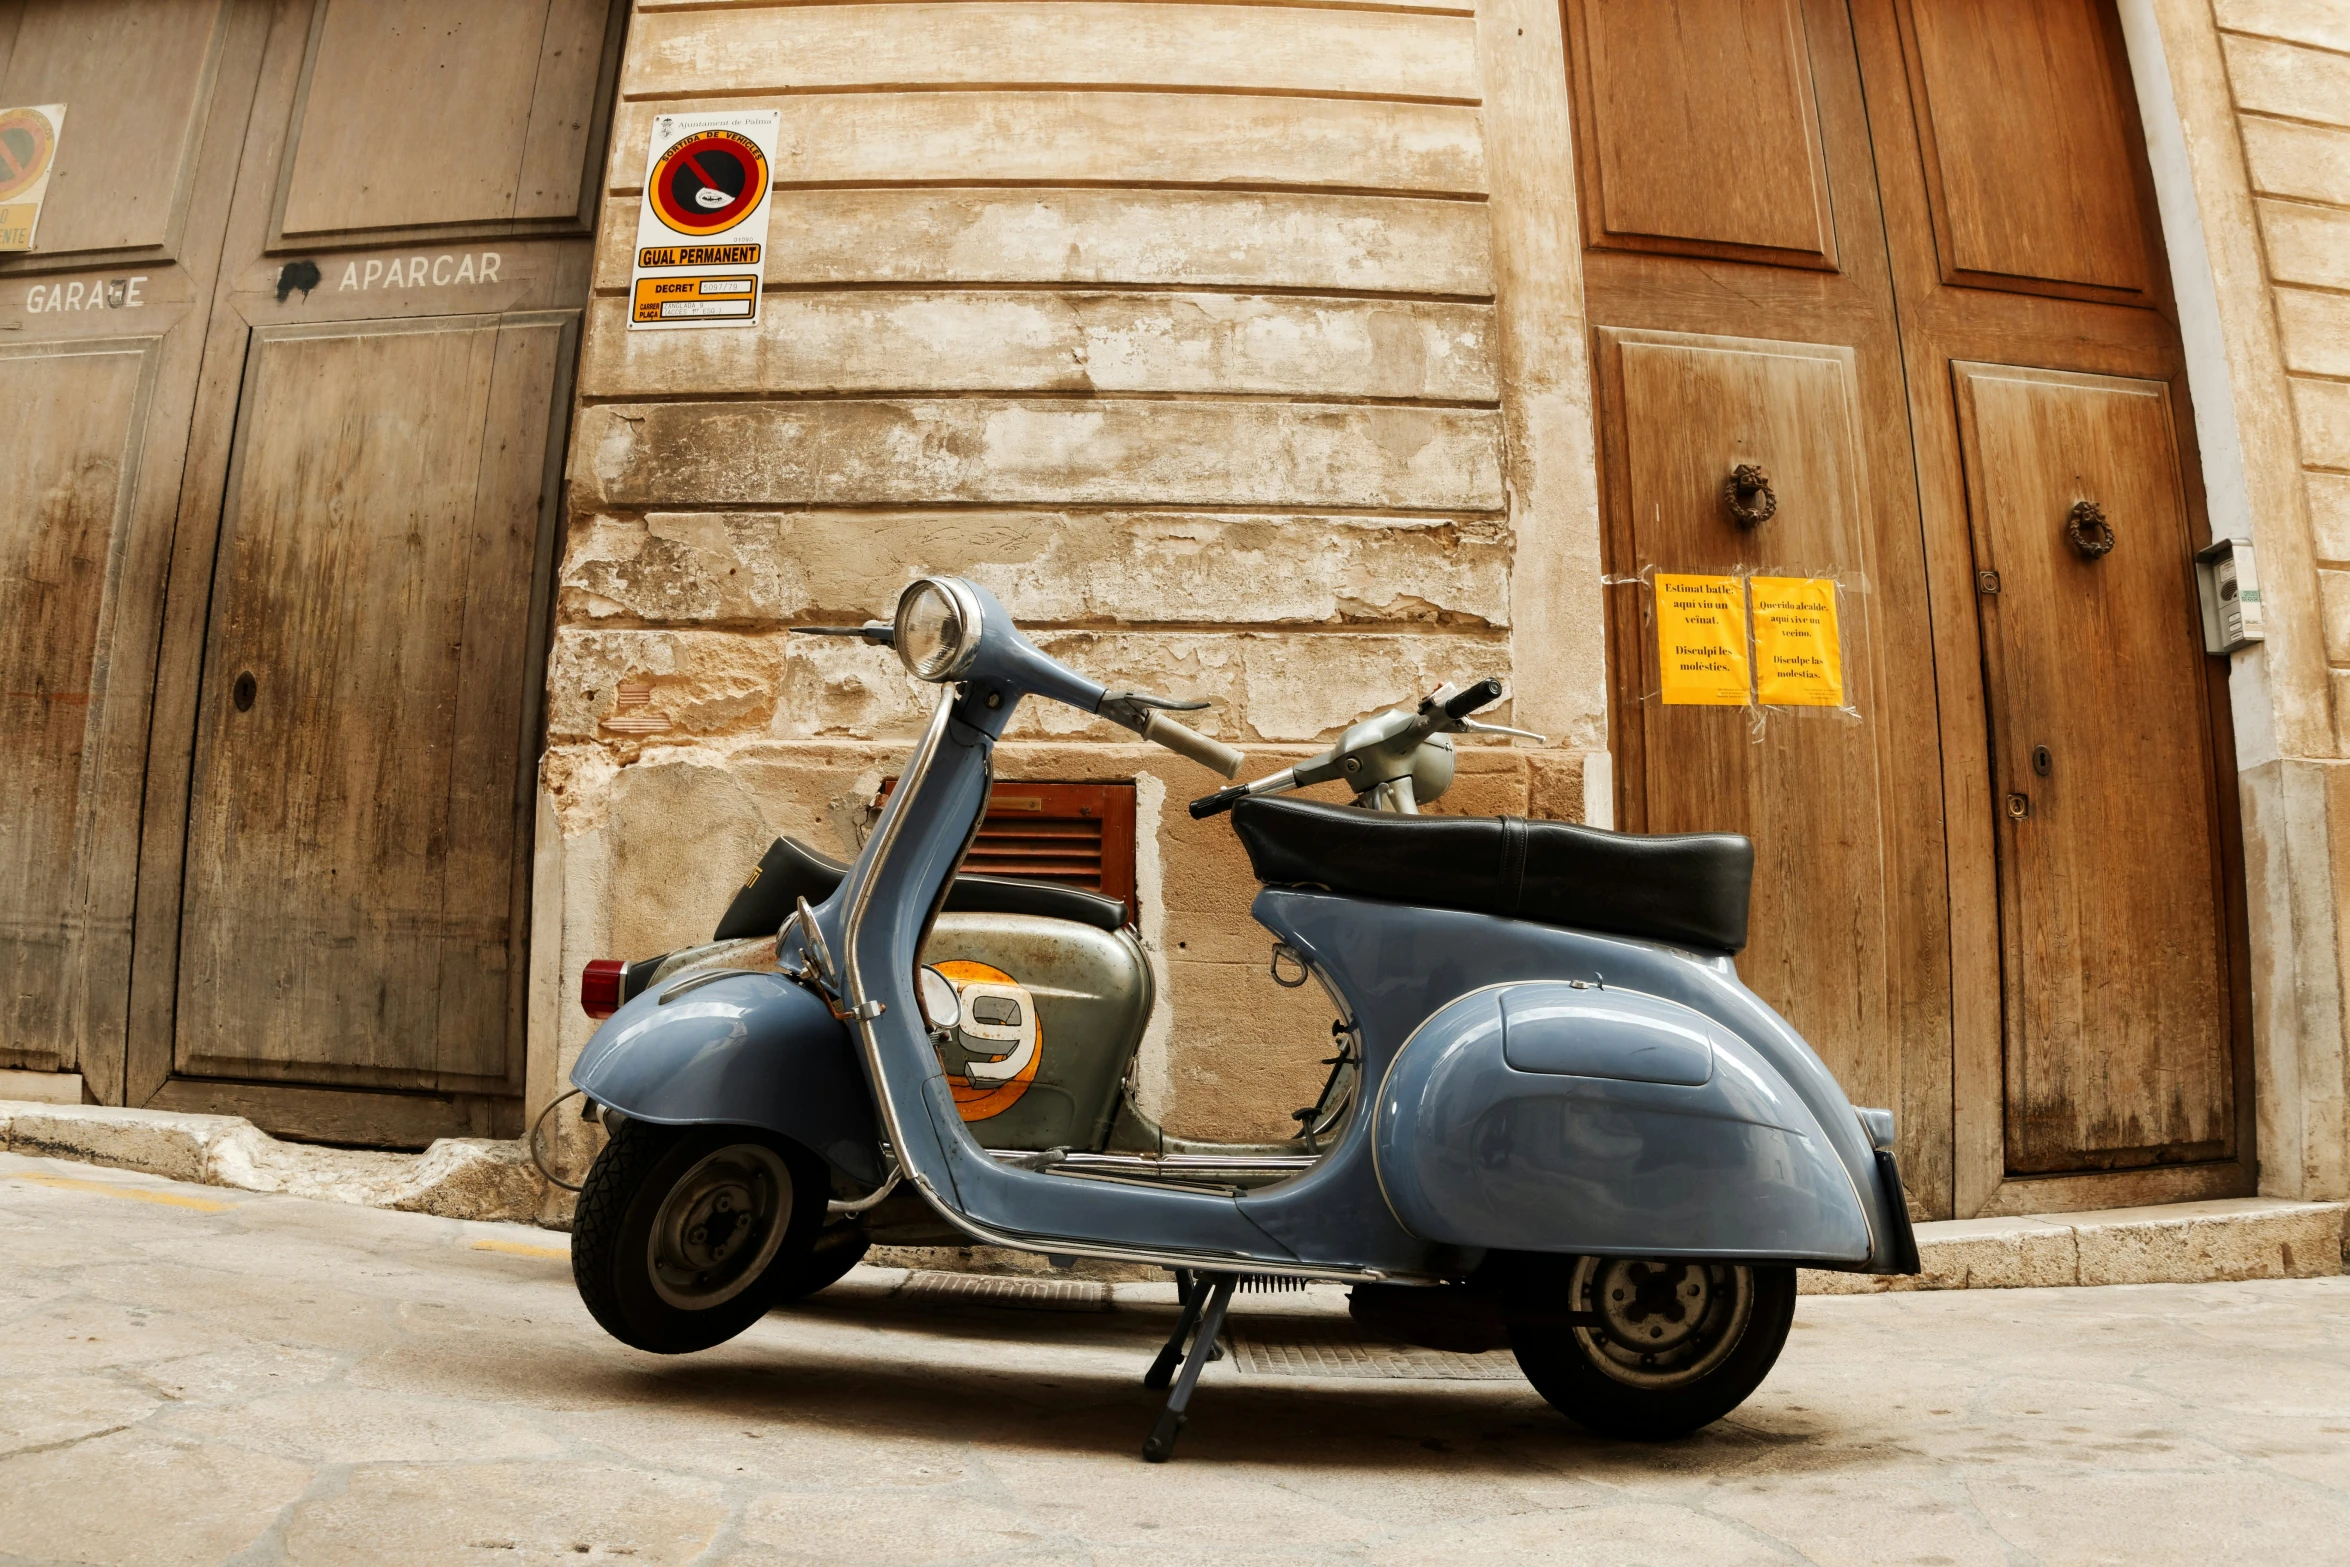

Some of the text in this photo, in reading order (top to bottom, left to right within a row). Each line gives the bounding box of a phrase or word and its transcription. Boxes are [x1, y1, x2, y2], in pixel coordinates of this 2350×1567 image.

[678, 120, 729, 130] Ajuntament
[661, 131, 763, 162] SORTIDA DE VEHICLES
[643, 246, 756, 266] GUAL PERMANENT
[338, 252, 502, 292] APARCAR
[655, 283, 694, 293] DECRET
[26, 276, 149, 314] GARAGE
[639, 302, 660, 310] CARRER
[639, 311, 658, 320] PLAÇA
[1665, 583, 1703, 594] Estimat
[1673, 599, 1729, 611] aquí viu un
[1759, 601, 1795, 611] Querido
[1685, 615, 1719, 625] veïnat.
[1770, 614, 1789, 625] aquí
[1790, 615, 1808, 624] vive
[1782, 628, 1812, 638] vecino.
[1675, 645, 1733, 658] Disculpi les
[1680, 661, 1730, 672] molèsties.
[1773, 655, 1824, 667] Disculpe las
[1777, 669, 1821, 679] molestias.
[958, 983, 1037, 1090] 9
